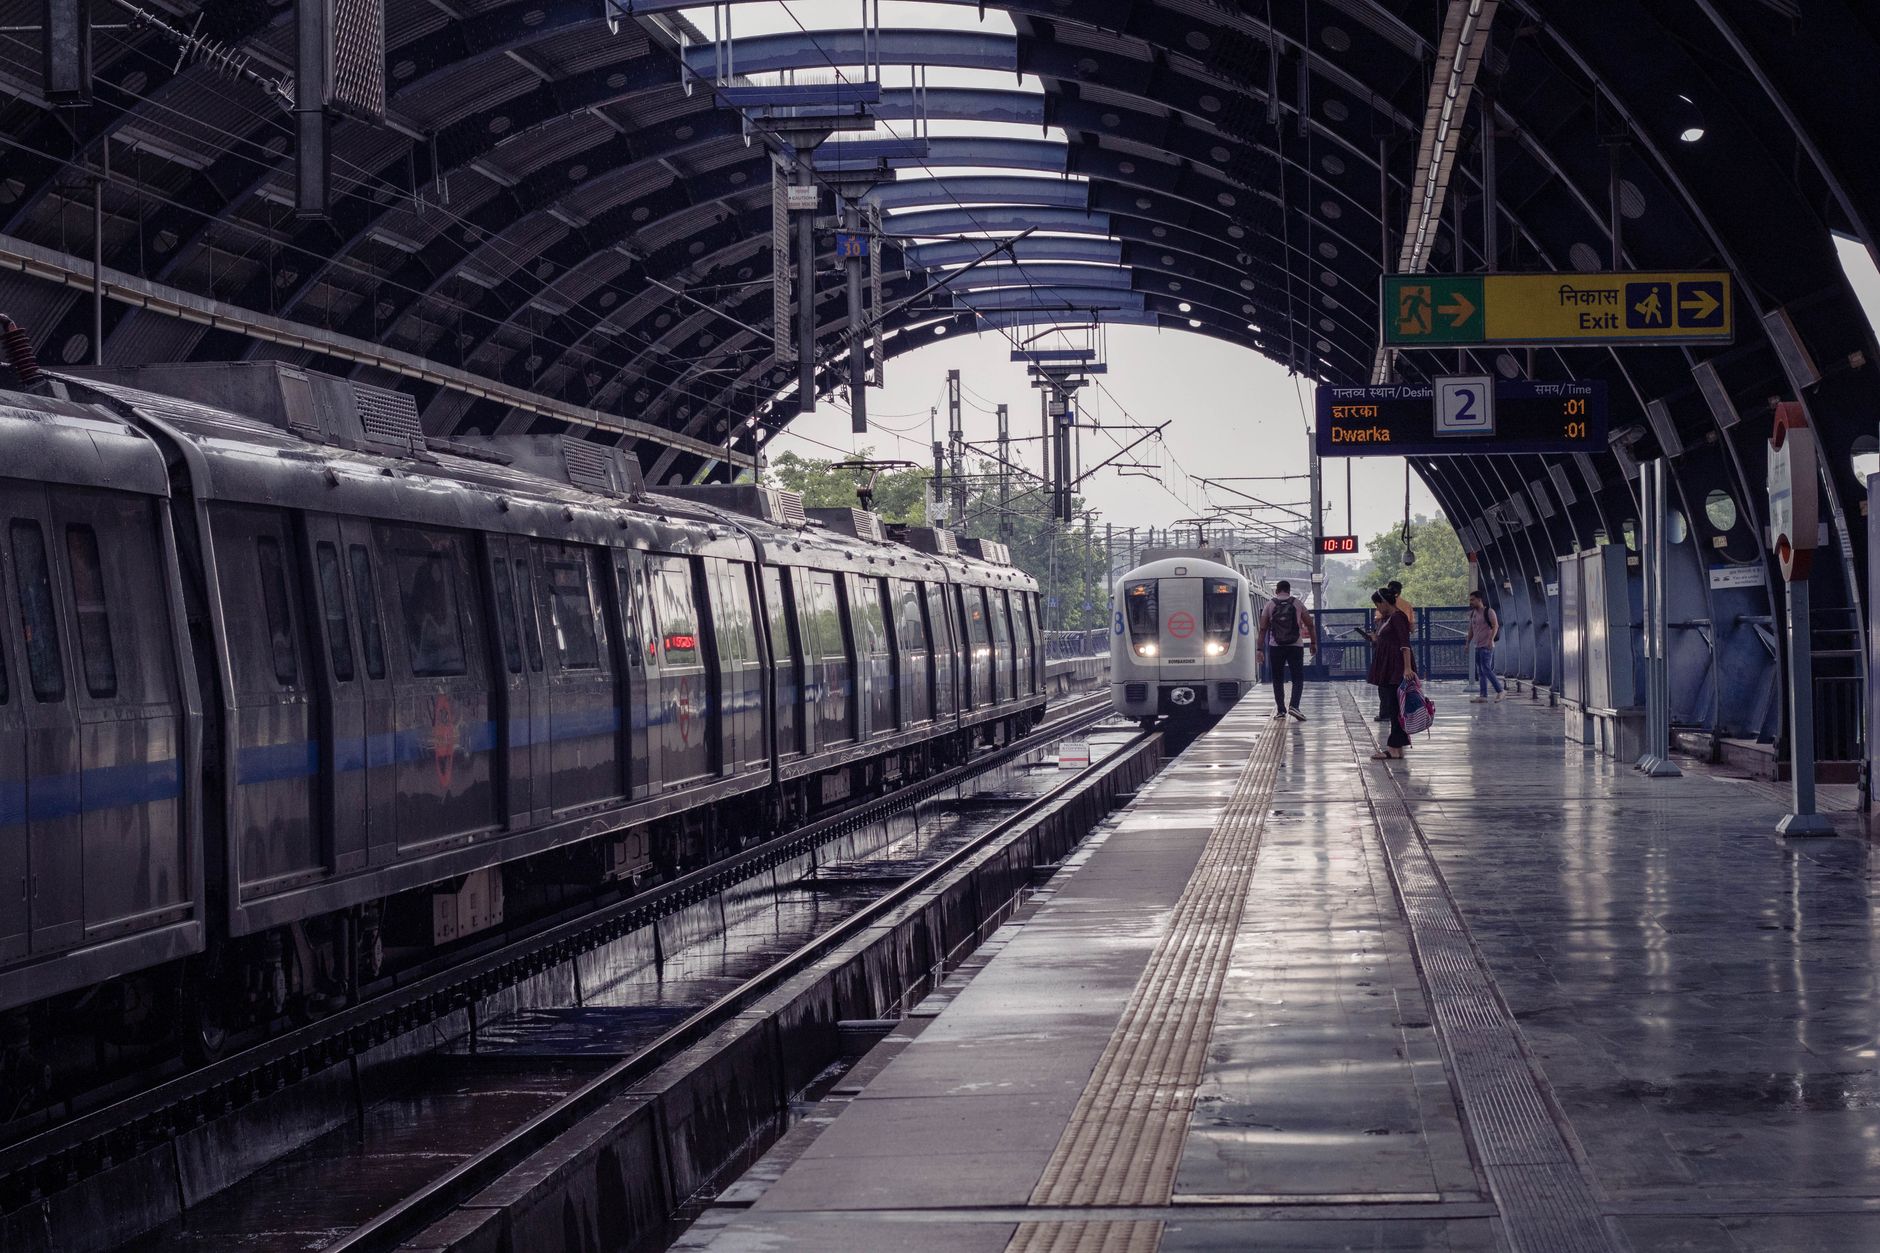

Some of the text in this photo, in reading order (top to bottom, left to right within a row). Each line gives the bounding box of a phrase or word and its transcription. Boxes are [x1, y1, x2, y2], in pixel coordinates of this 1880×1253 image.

[1558, 284, 1620, 306] निकास
[1579, 312, 1619, 330] Exit
[1332, 405, 1378, 418] द्वारका
[1454, 389, 1477, 421] 2
[1563, 399, 1585, 415] :01
[1331, 426, 1391, 443] Dwarka
[1564, 422, 1585, 438] :01
[1323, 539, 1353, 551] 10:10
[1114, 611, 1125, 636] 8
[1238, 611, 1249, 636] 8
